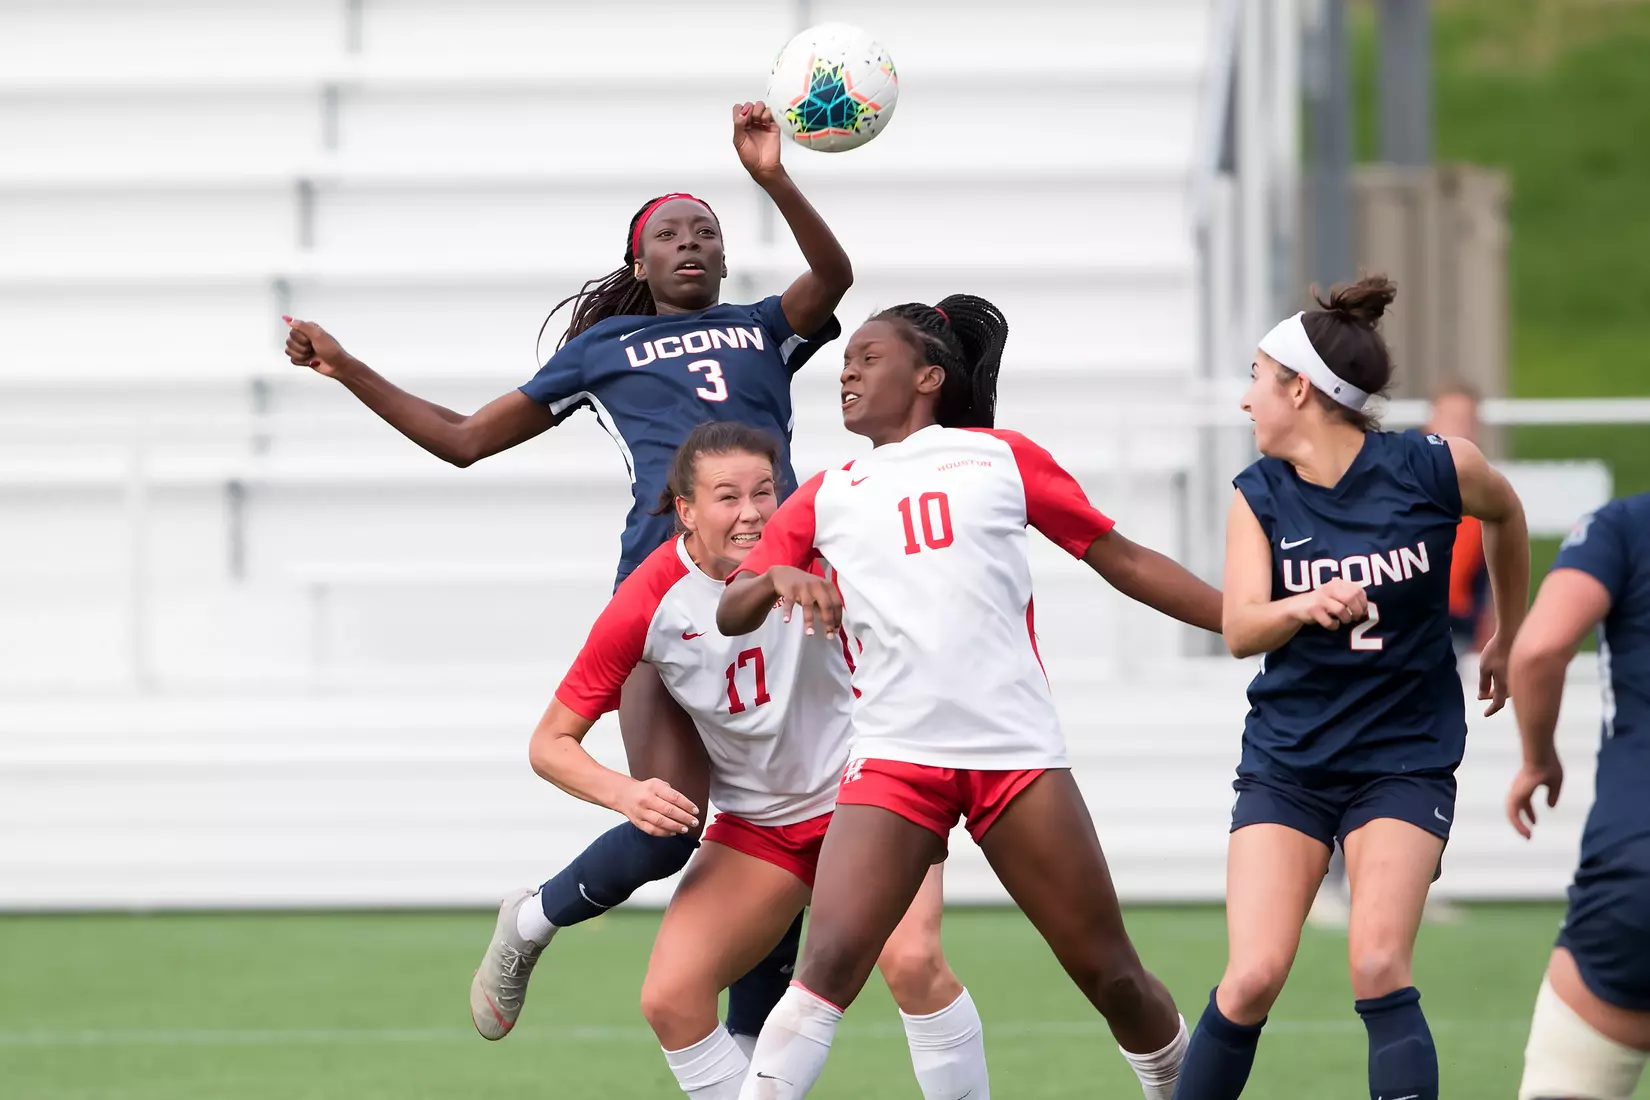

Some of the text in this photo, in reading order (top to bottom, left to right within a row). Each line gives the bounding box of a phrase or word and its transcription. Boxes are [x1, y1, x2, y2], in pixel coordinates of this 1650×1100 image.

[625, 326, 764, 368] UCONN
[687, 359, 729, 402] 3
[937, 459, 992, 472] HOUSTON
[897, 491, 955, 556] 10
[1283, 541, 1431, 593] UCONN
[1350, 601, 1383, 651] 2
[725, 646, 771, 715] 17
